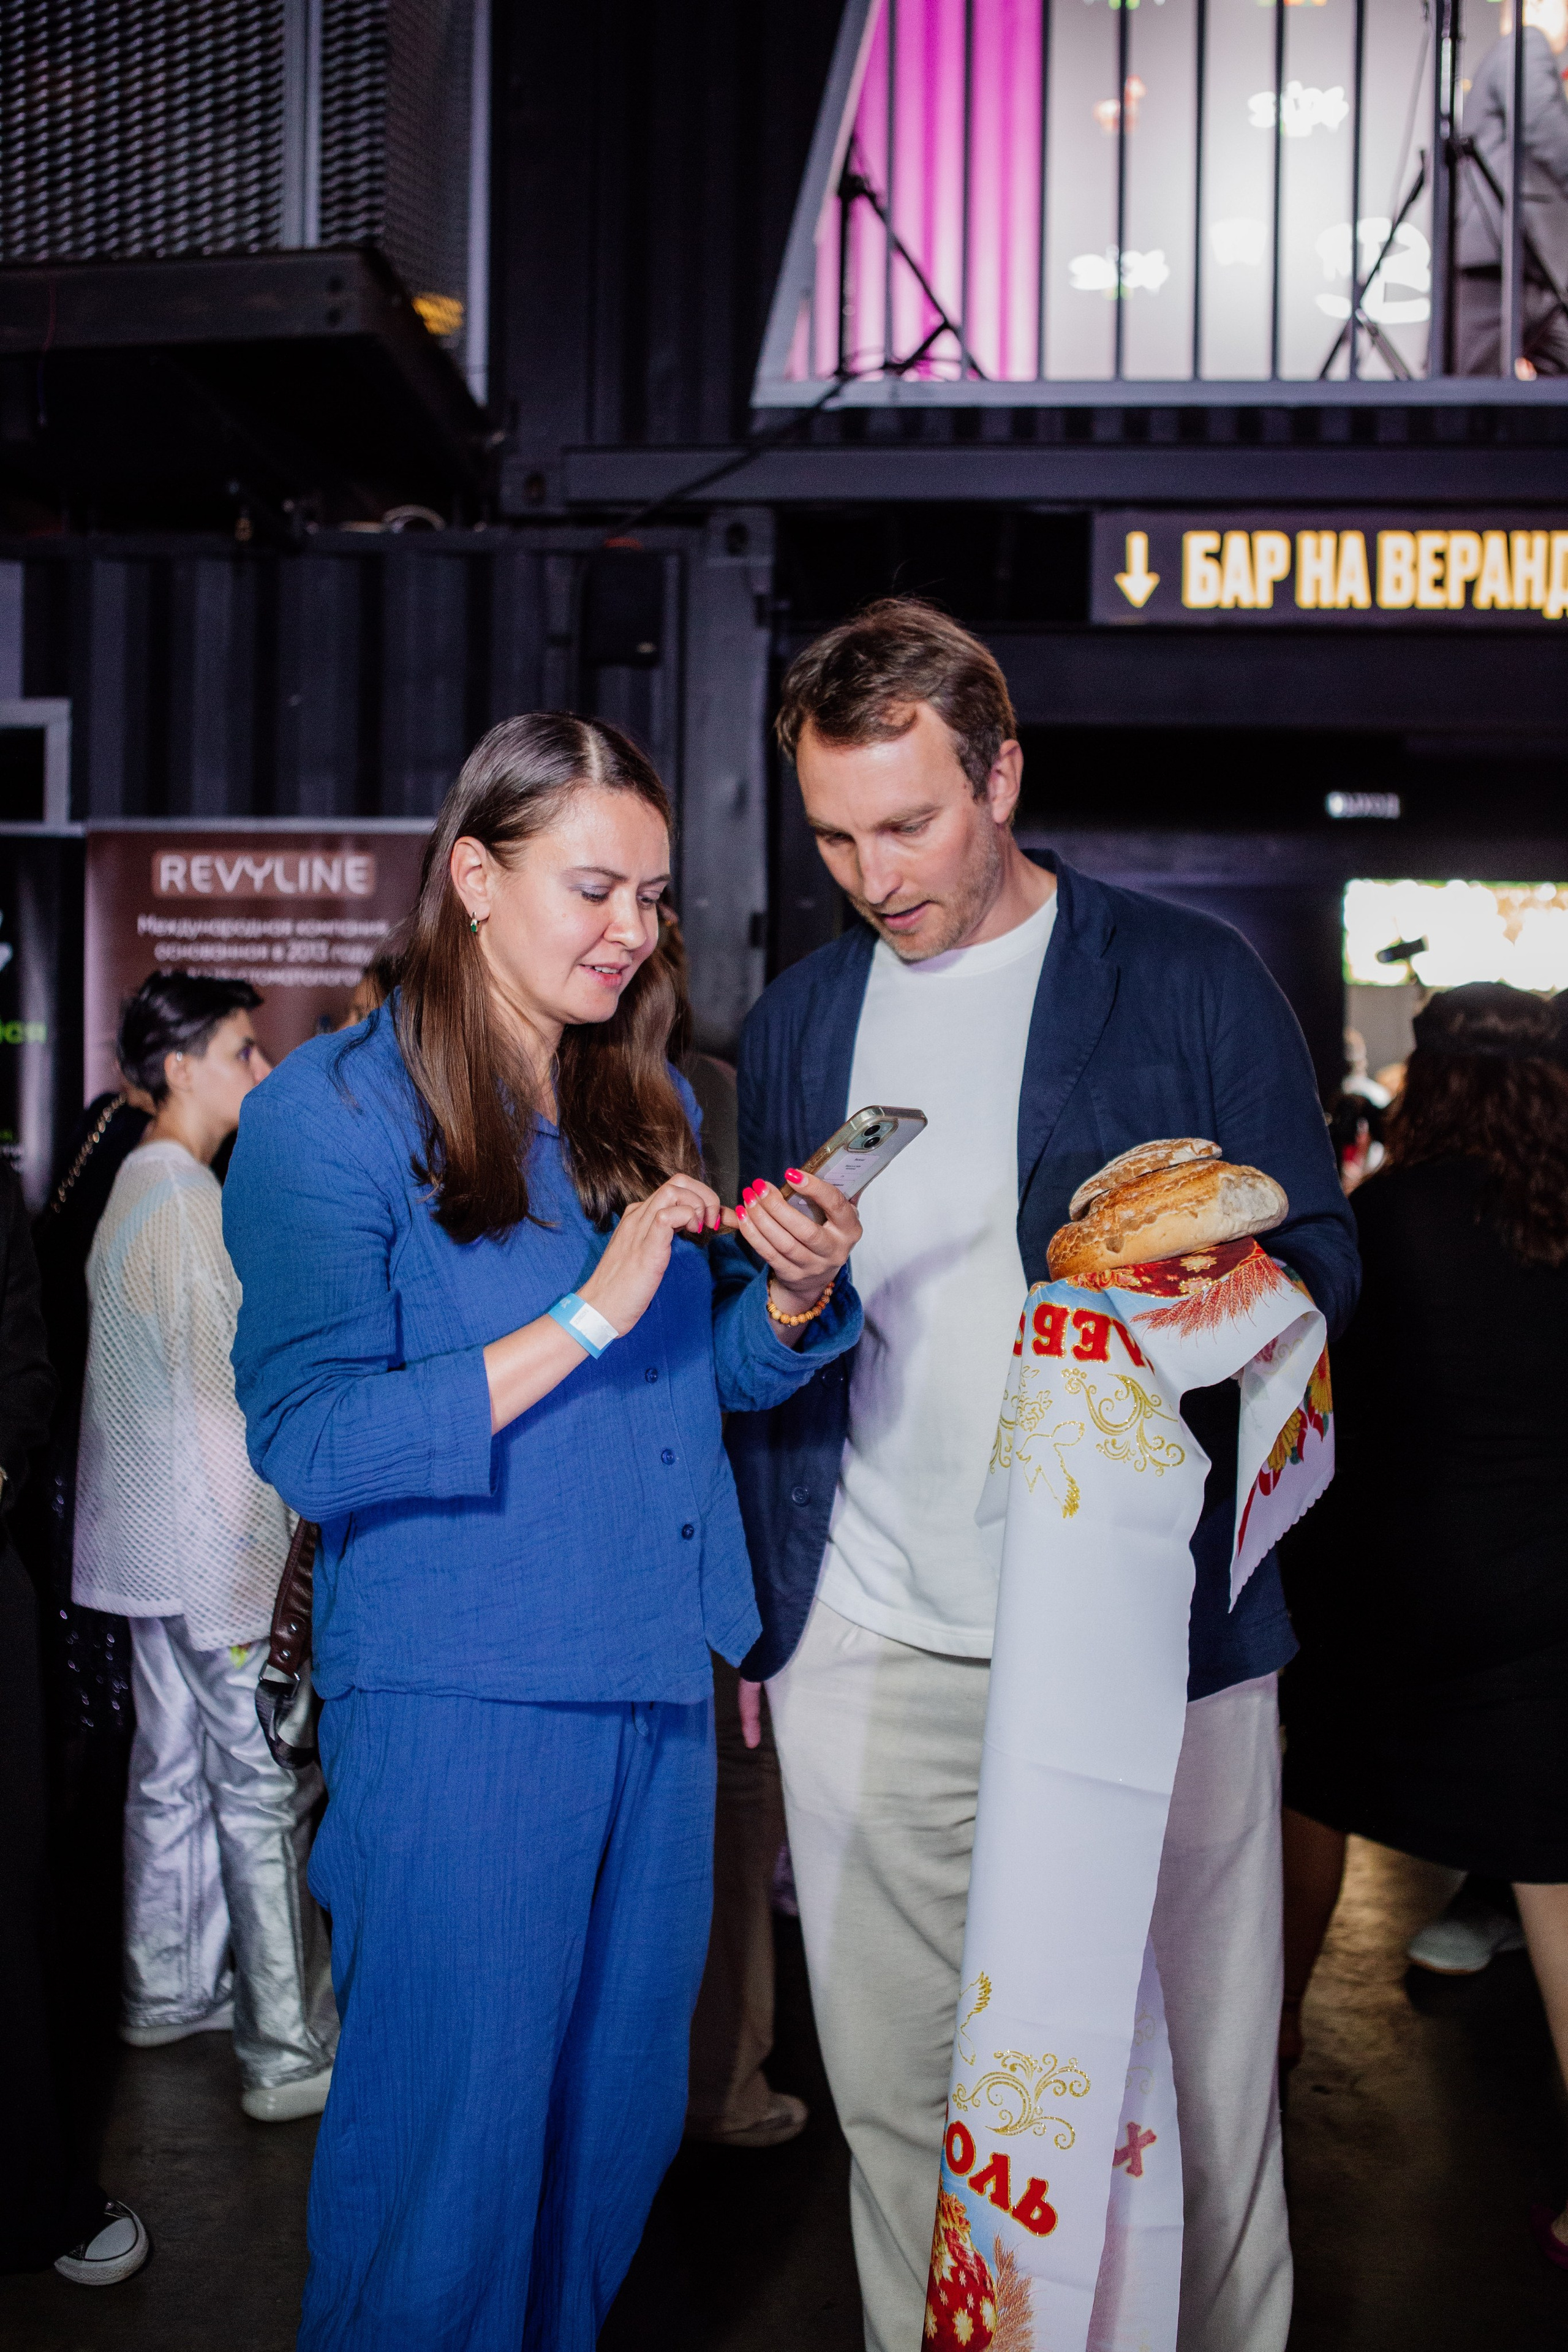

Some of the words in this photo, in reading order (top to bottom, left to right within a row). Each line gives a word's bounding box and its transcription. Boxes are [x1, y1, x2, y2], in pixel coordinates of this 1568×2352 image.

[1183, 531, 1291, 609] БАР
[1295, 531, 1372, 609] НА
[160, 855, 369, 894] REVYLINE
[943, 2107, 1058, 2237] ОЛЬ
